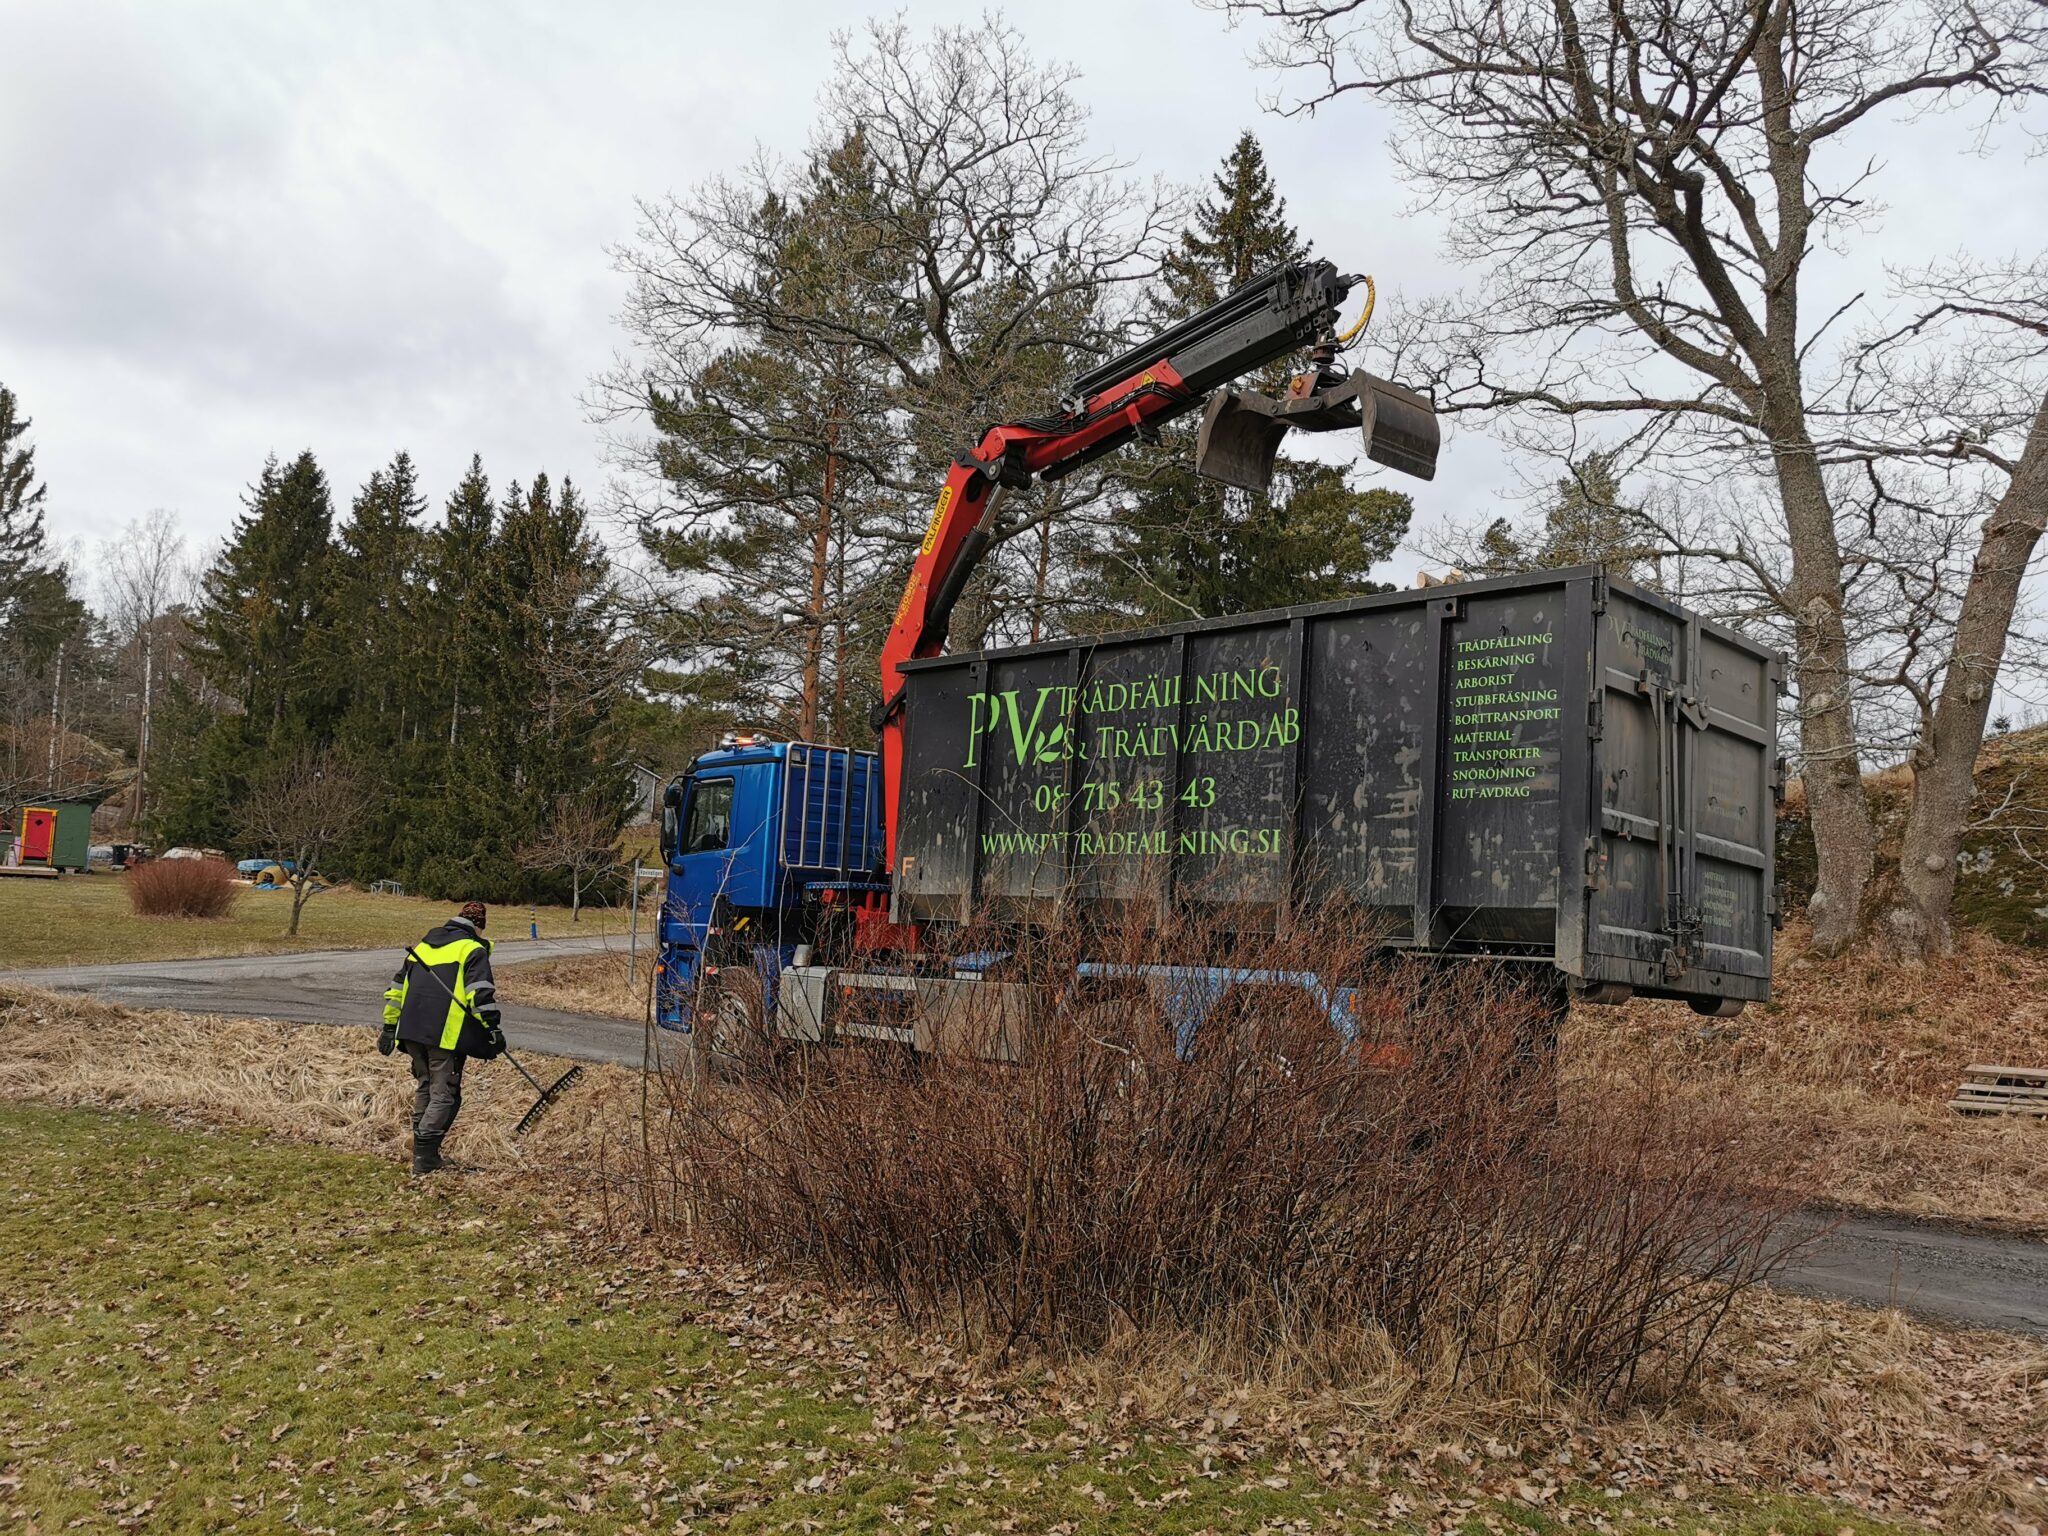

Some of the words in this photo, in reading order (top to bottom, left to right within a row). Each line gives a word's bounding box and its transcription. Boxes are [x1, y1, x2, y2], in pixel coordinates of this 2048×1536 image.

[924, 490, 951, 552] PALFINGER
[1457, 633, 1553, 653] TRÄDFÄLLNING
[1457, 653, 1535, 671] BESKÄRNING
[1455, 673, 1515, 690] ARBORIST
[1455, 689, 1558, 708] STUBBFRÄSNING
[1455, 708, 1561, 726] BORTTRANSPORT
[963, 686, 1055, 768] PV
[1262, 708, 1300, 748] AB
[1454, 730, 1516, 744] MATERIAL-
[1453, 747, 1541, 763] TRANSPORTER
[1452, 766, 1536, 782] SNÖRÖJNING
[1083, 781, 1121, 812] 715
[1129, 780, 1164, 810] 43
[1181, 776, 1216, 808] 43
[1451, 786, 1530, 799] RUT-AVDRAG
[902, 856, 915, 877] F
